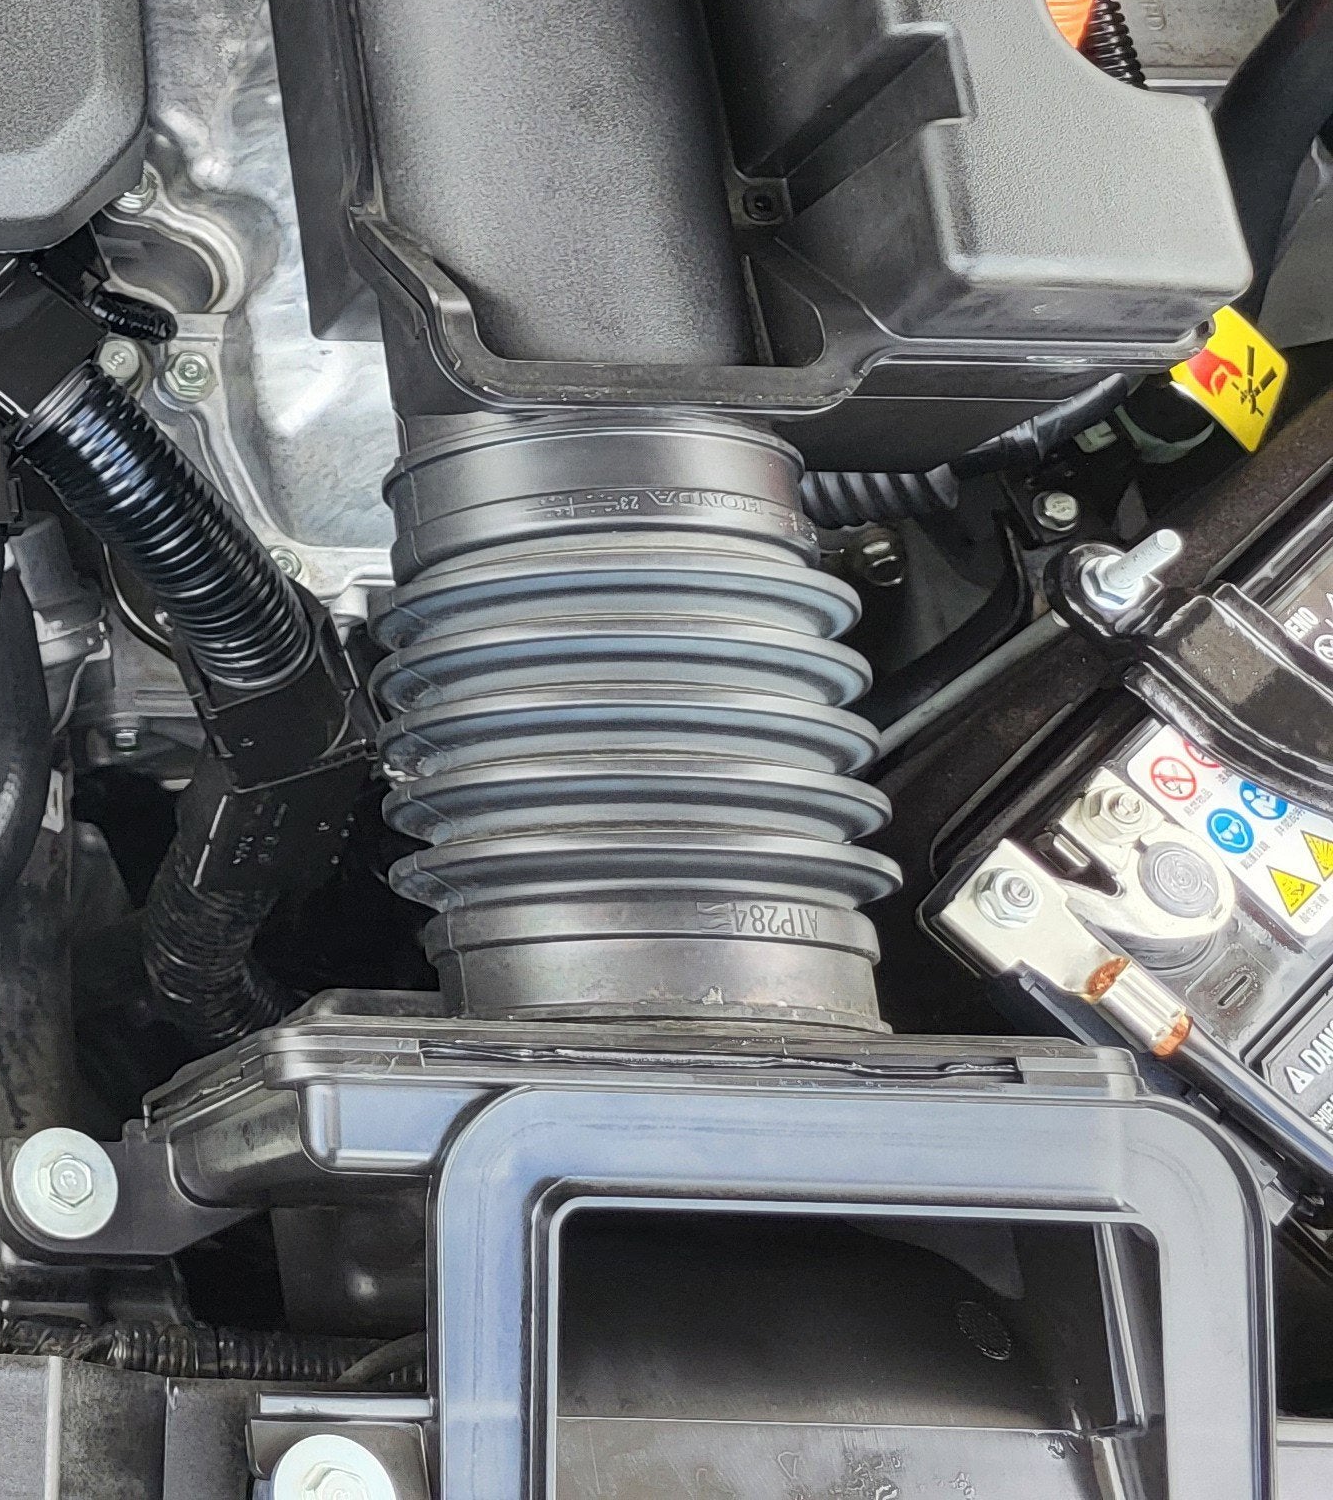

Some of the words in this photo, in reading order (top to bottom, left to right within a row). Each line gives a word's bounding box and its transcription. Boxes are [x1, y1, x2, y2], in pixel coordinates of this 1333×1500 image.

[645, 488, 765, 516] HONDA
[731, 902, 819, 939] ATP284
[1299, 1018, 1333, 1073] DAN
